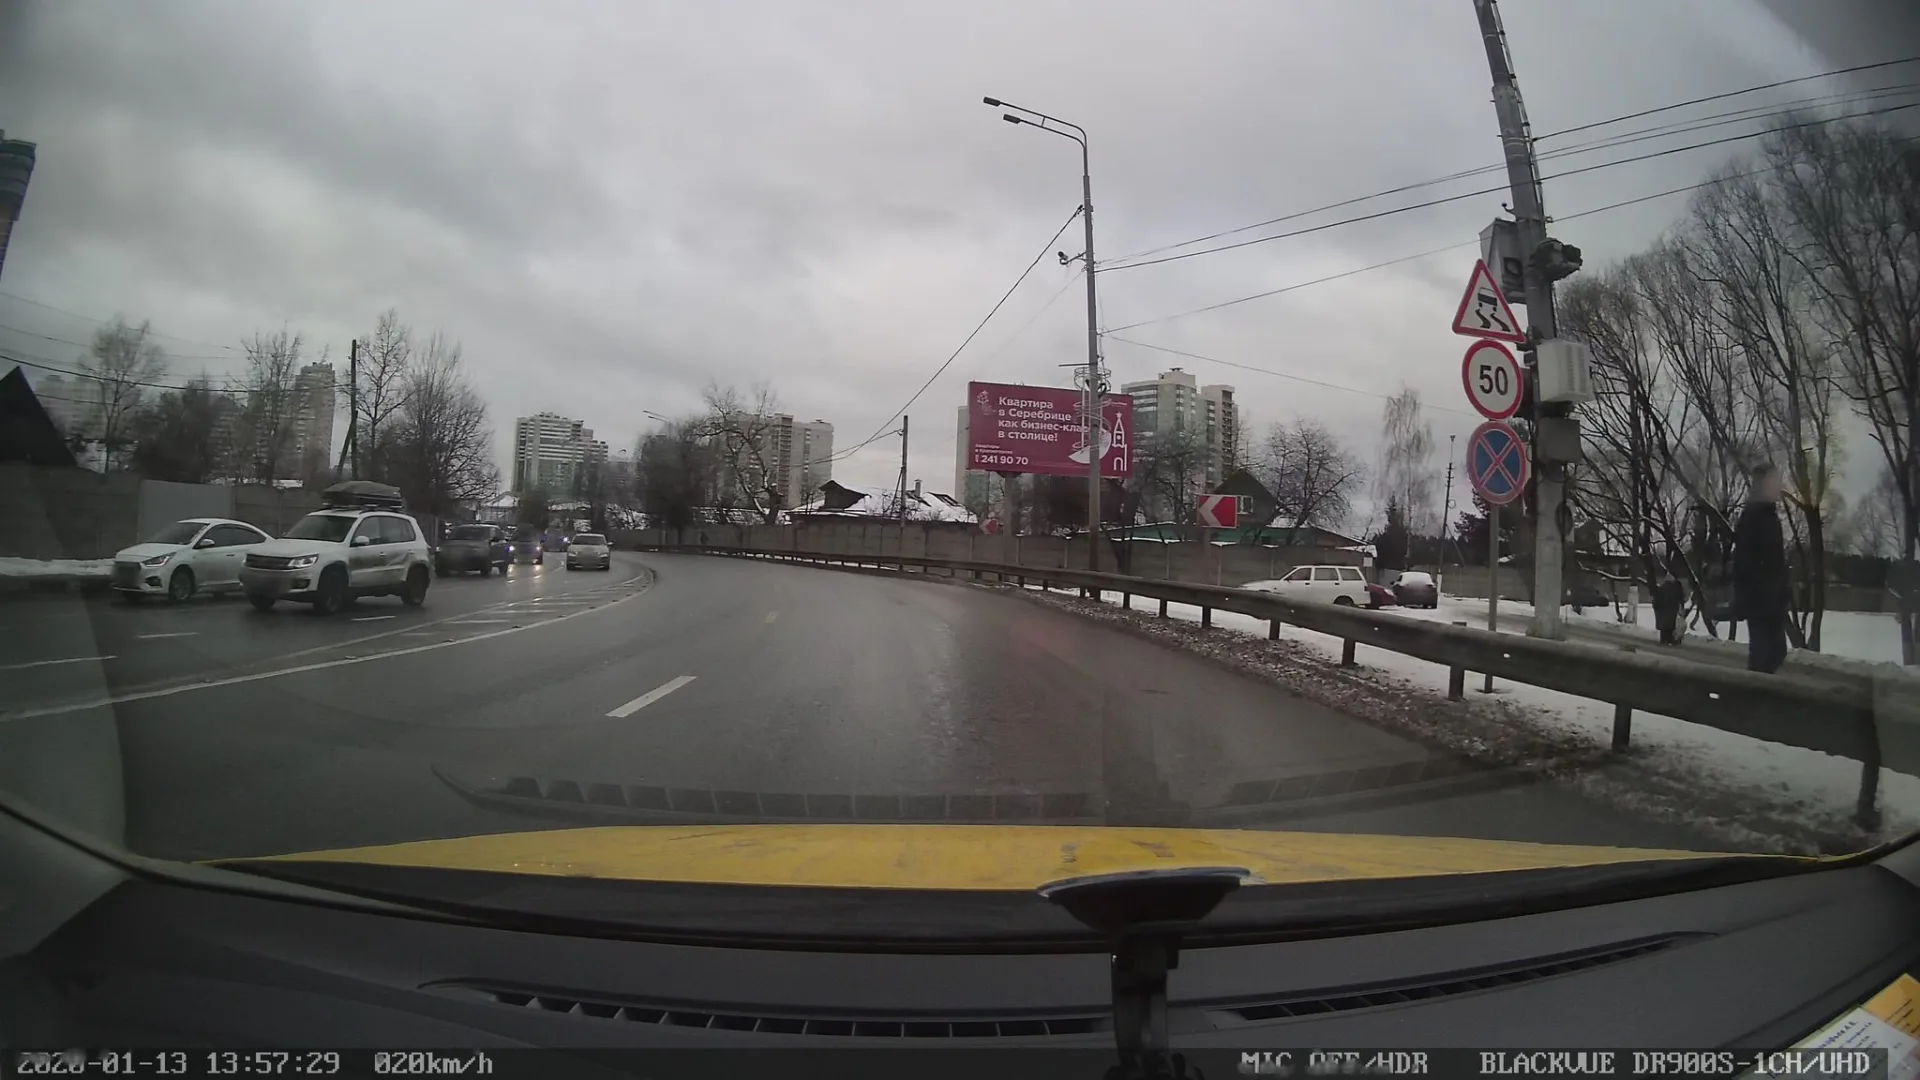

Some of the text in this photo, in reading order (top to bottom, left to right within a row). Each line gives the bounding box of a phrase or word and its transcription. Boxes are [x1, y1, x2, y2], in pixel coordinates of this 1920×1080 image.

[1479, 364, 1508, 396] 50
[998, 396, 1054, 410] Квартира
[1008, 408, 1072, 421] Серебрице
[998, 419, 1018, 428] как
[998, 430, 1058, 442] в столице!
[981, 454, 998, 464] 241
[1000, 455, 1014, 465] 90
[1015, 456, 1029, 465] 70
